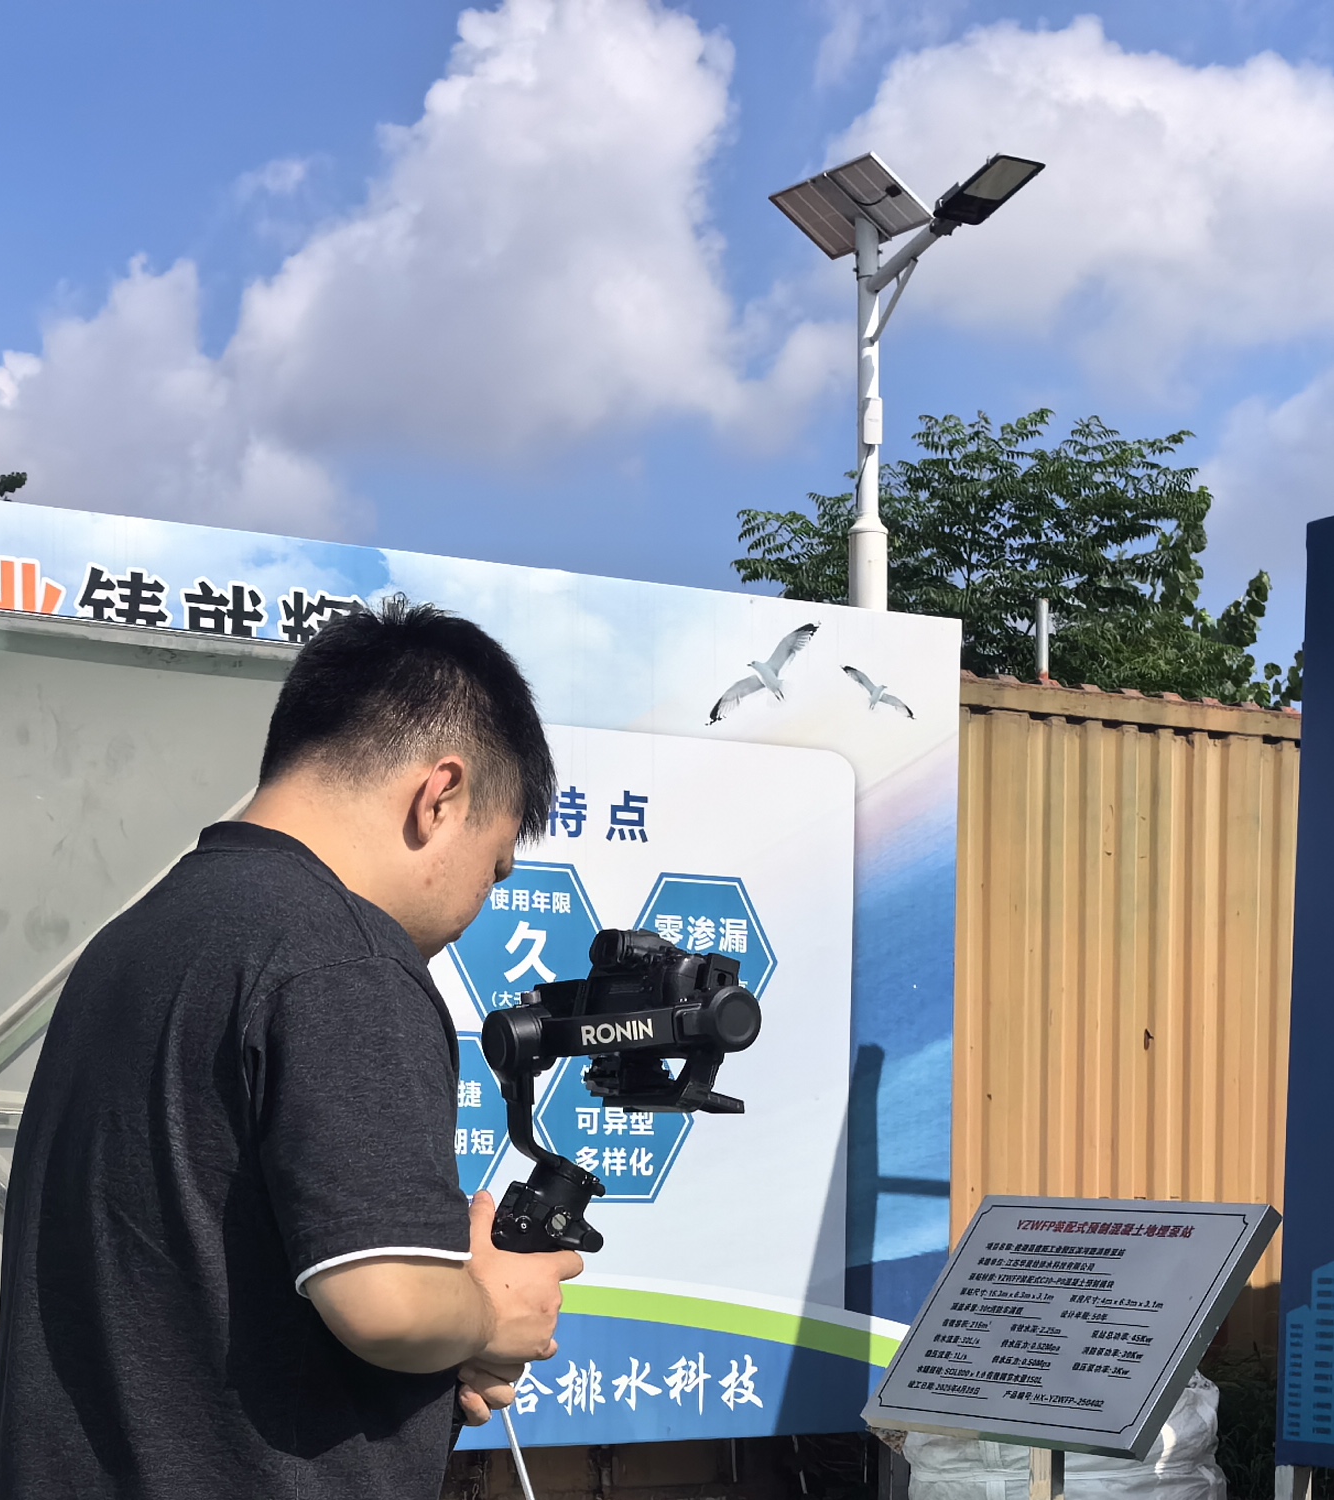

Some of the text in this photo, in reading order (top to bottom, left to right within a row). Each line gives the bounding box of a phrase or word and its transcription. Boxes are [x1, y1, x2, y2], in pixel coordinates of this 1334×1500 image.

[550, 786, 649, 843] 特点
[489, 886, 572, 914] 使用年限
[653, 913, 749, 954] 零渗漏
[503, 920, 557, 984] 久
[580, 1018, 654, 1046] RONIN
[574, 1106, 655, 1136] 可异型
[574, 1146, 655, 1177] 多样化
